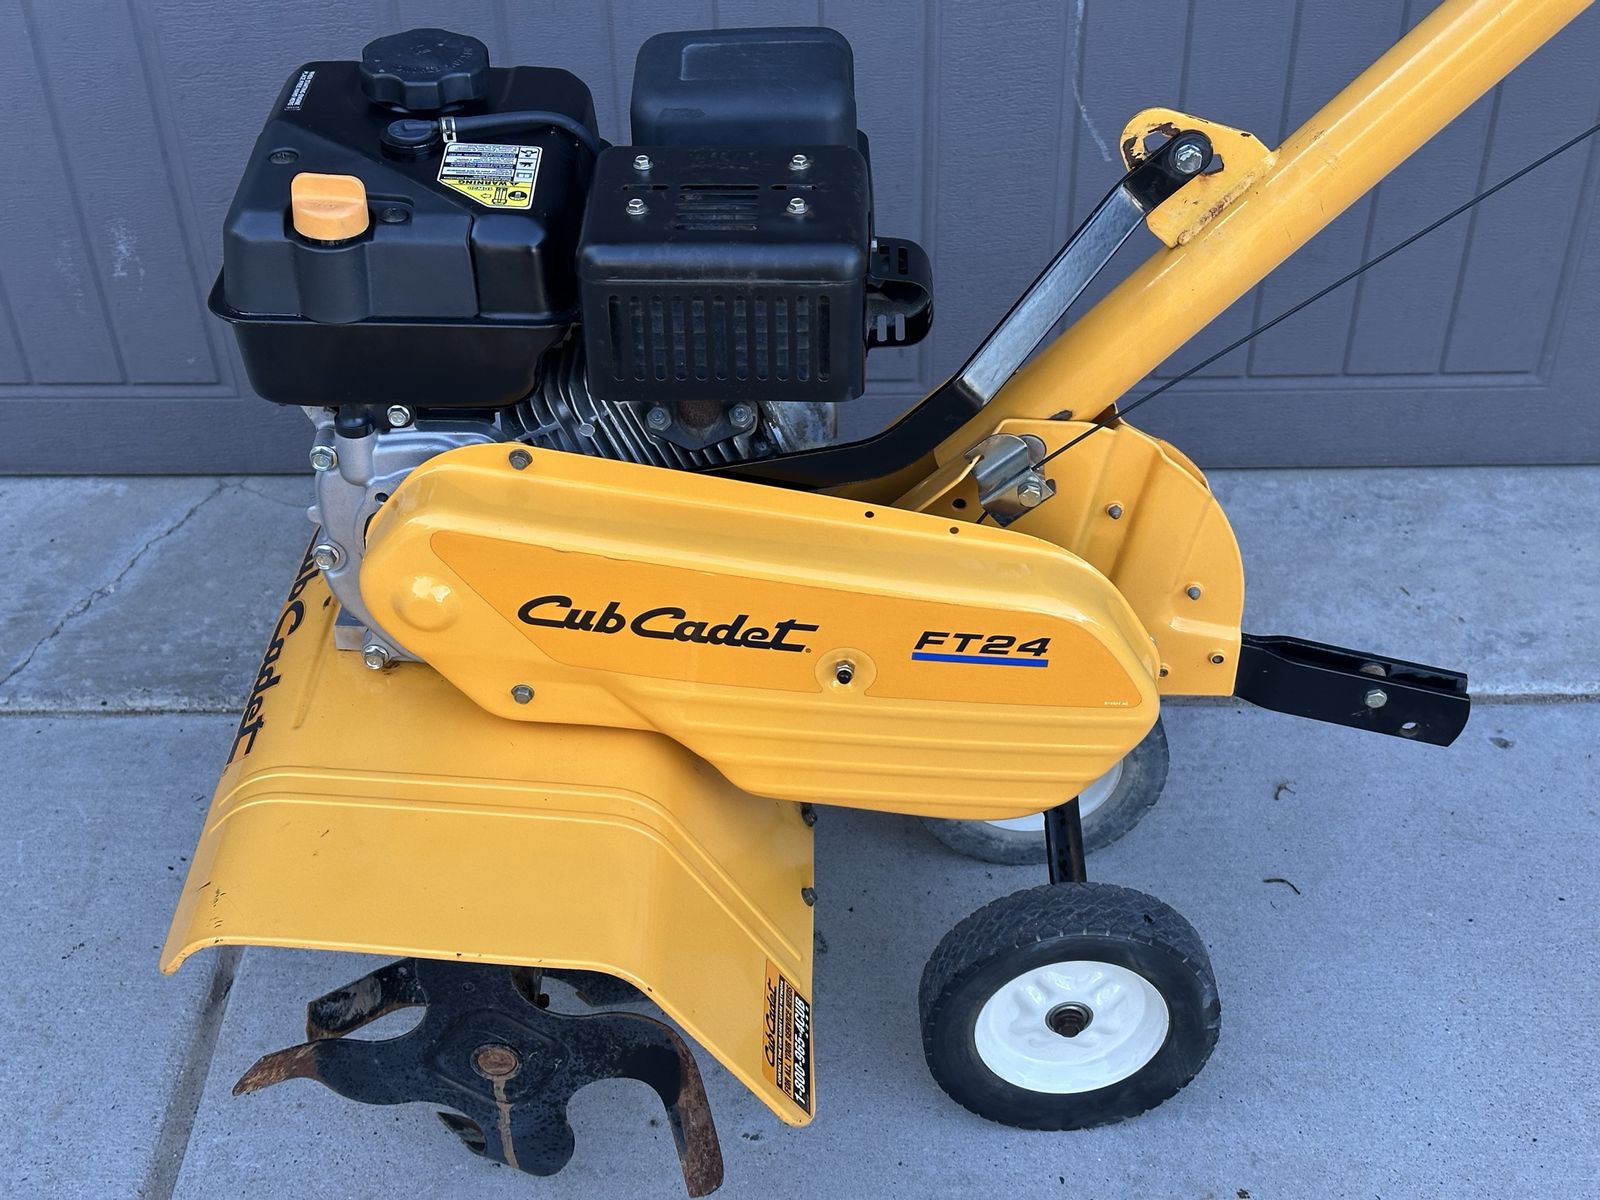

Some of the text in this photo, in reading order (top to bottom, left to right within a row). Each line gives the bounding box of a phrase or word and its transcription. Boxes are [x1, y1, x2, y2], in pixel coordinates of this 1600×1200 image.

[458, 179, 507, 187] WARNING
[518, 595, 819, 653] Cub Cadet
[914, 630, 1052, 657] FT24
[226, 600, 306, 766] Cadet
[765, 976, 776, 1068] Cub Cadet
[784, 1062, 792, 1079] ALL
[794, 995, 805, 1105] 1-800-965-4CUB
[784, 1077, 792, 1096] FOR
